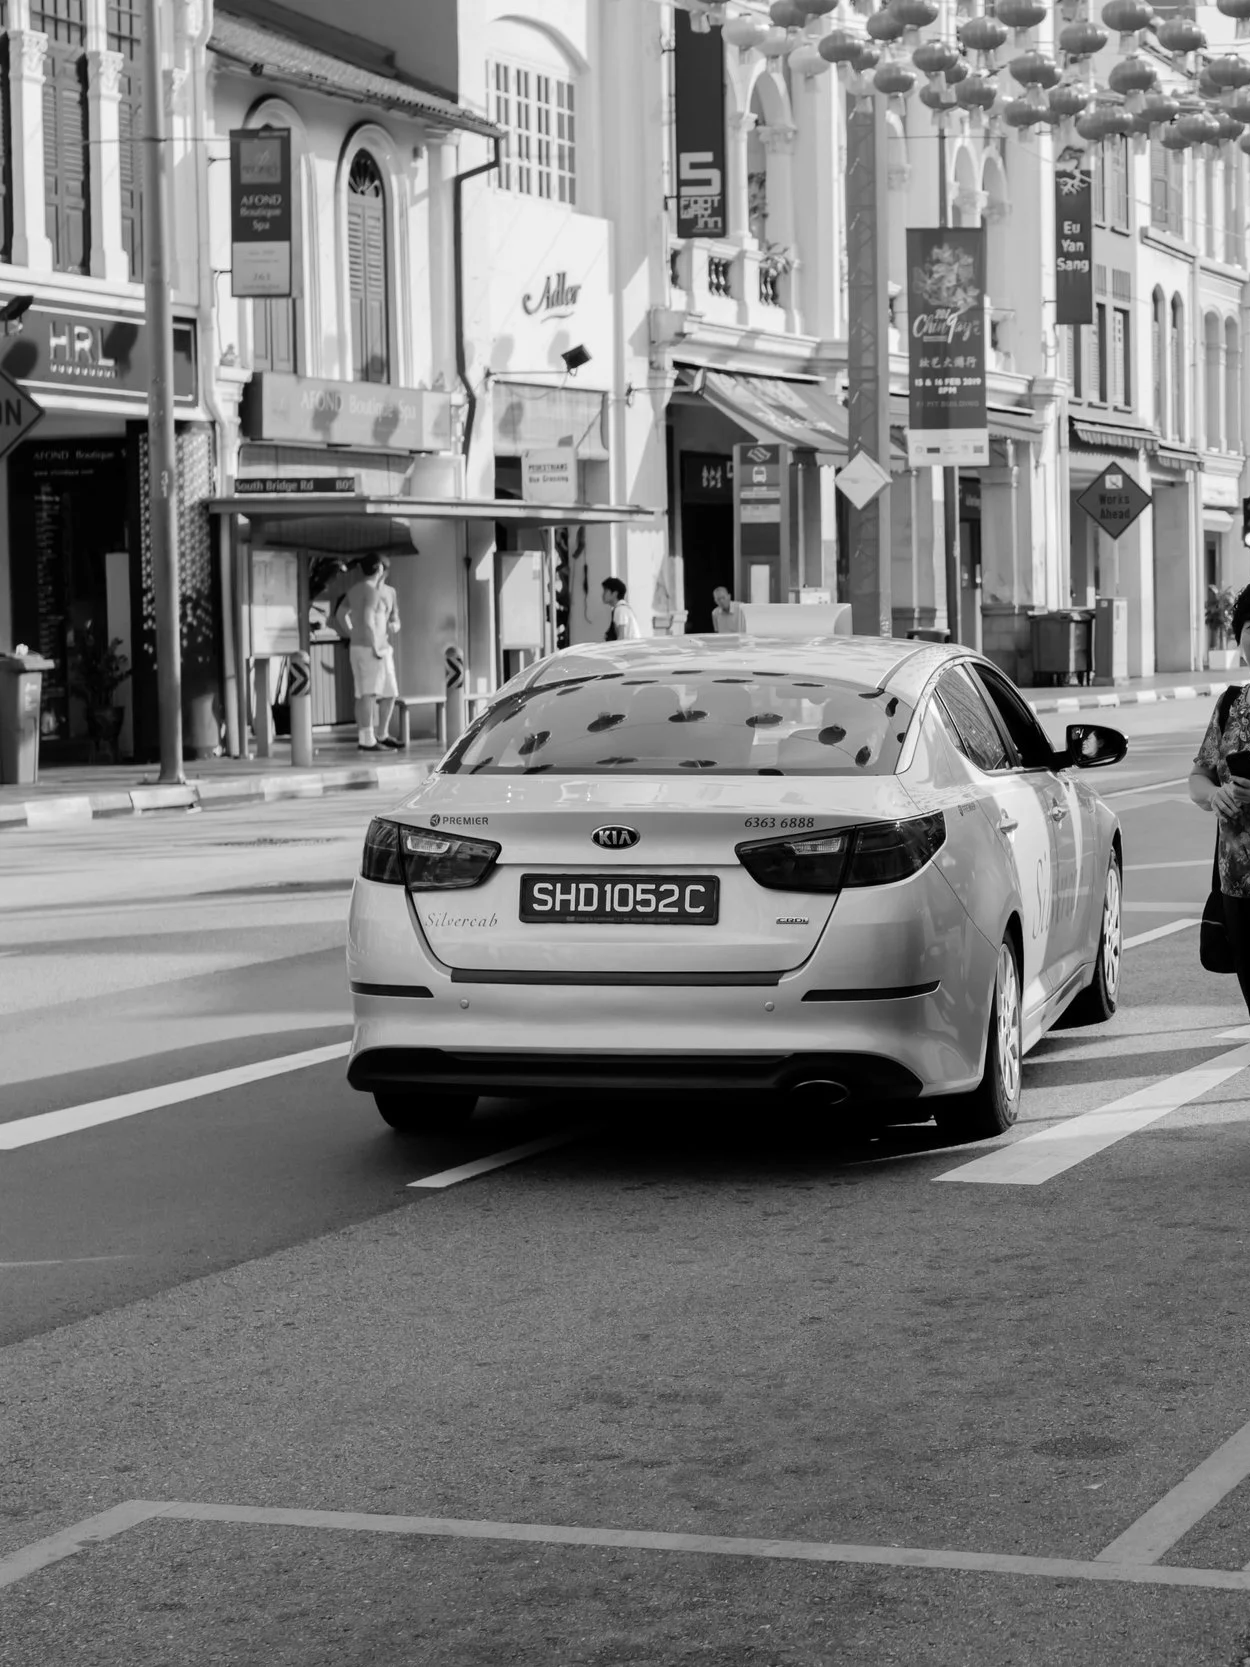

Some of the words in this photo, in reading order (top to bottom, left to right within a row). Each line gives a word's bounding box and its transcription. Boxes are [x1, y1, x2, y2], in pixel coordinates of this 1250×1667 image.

[680, 151, 722, 196] 5
[1063, 220, 1081, 235] Eu
[1061, 239, 1085, 252] Yan
[1057, 257, 1090, 273] Sang
[521, 271, 582, 316] Adler
[49, 322, 115, 367] HRL
[301, 389, 342, 412] AFOND
[235, 480, 264, 492] South
[266, 479, 298, 492] Bridge
[300, 479, 314, 491] Rd
[1098, 493, 1130, 505] Works
[1099, 507, 1130, 520] Ahead
[442, 816, 489, 826] PREMIER
[744, 817, 776, 828] 6363
[780, 817, 815, 829] 6888
[598, 830, 632, 845] KIA
[424, 911, 498, 928] Silvercab
